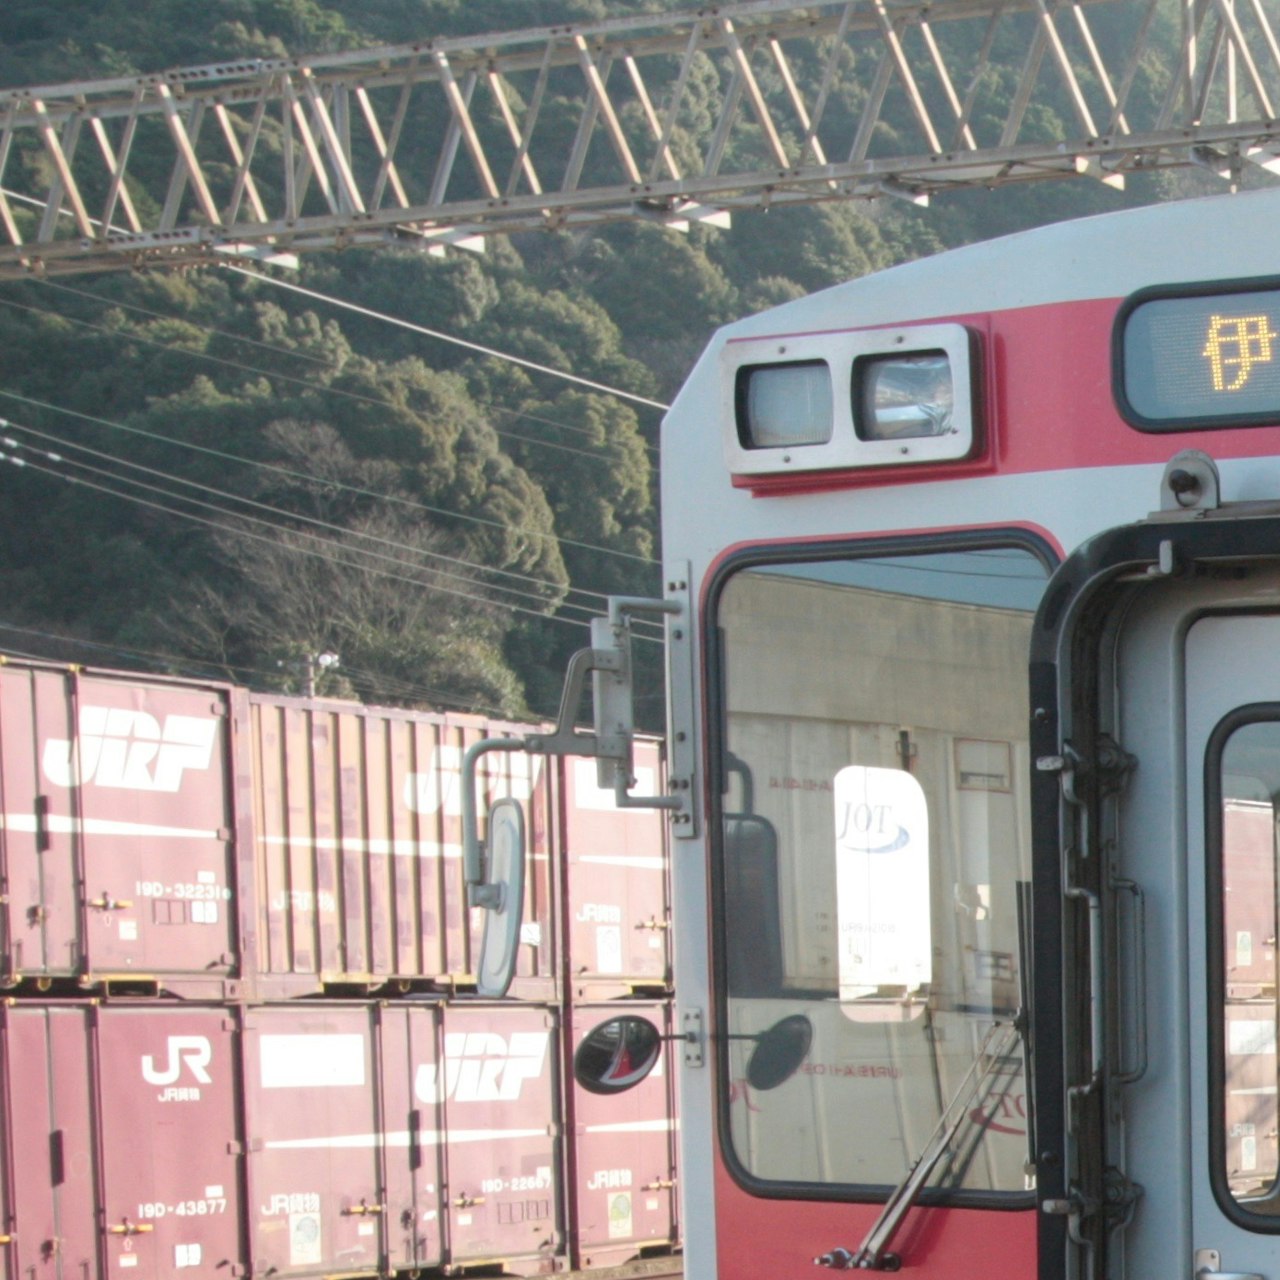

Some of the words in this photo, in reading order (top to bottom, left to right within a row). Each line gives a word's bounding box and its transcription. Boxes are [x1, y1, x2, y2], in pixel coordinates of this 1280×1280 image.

[42, 705, 216, 792] JRF
[837, 801, 893, 841] JOT
[141, 1036, 212, 1085] JR
[415, 1032, 549, 1103] JRF
